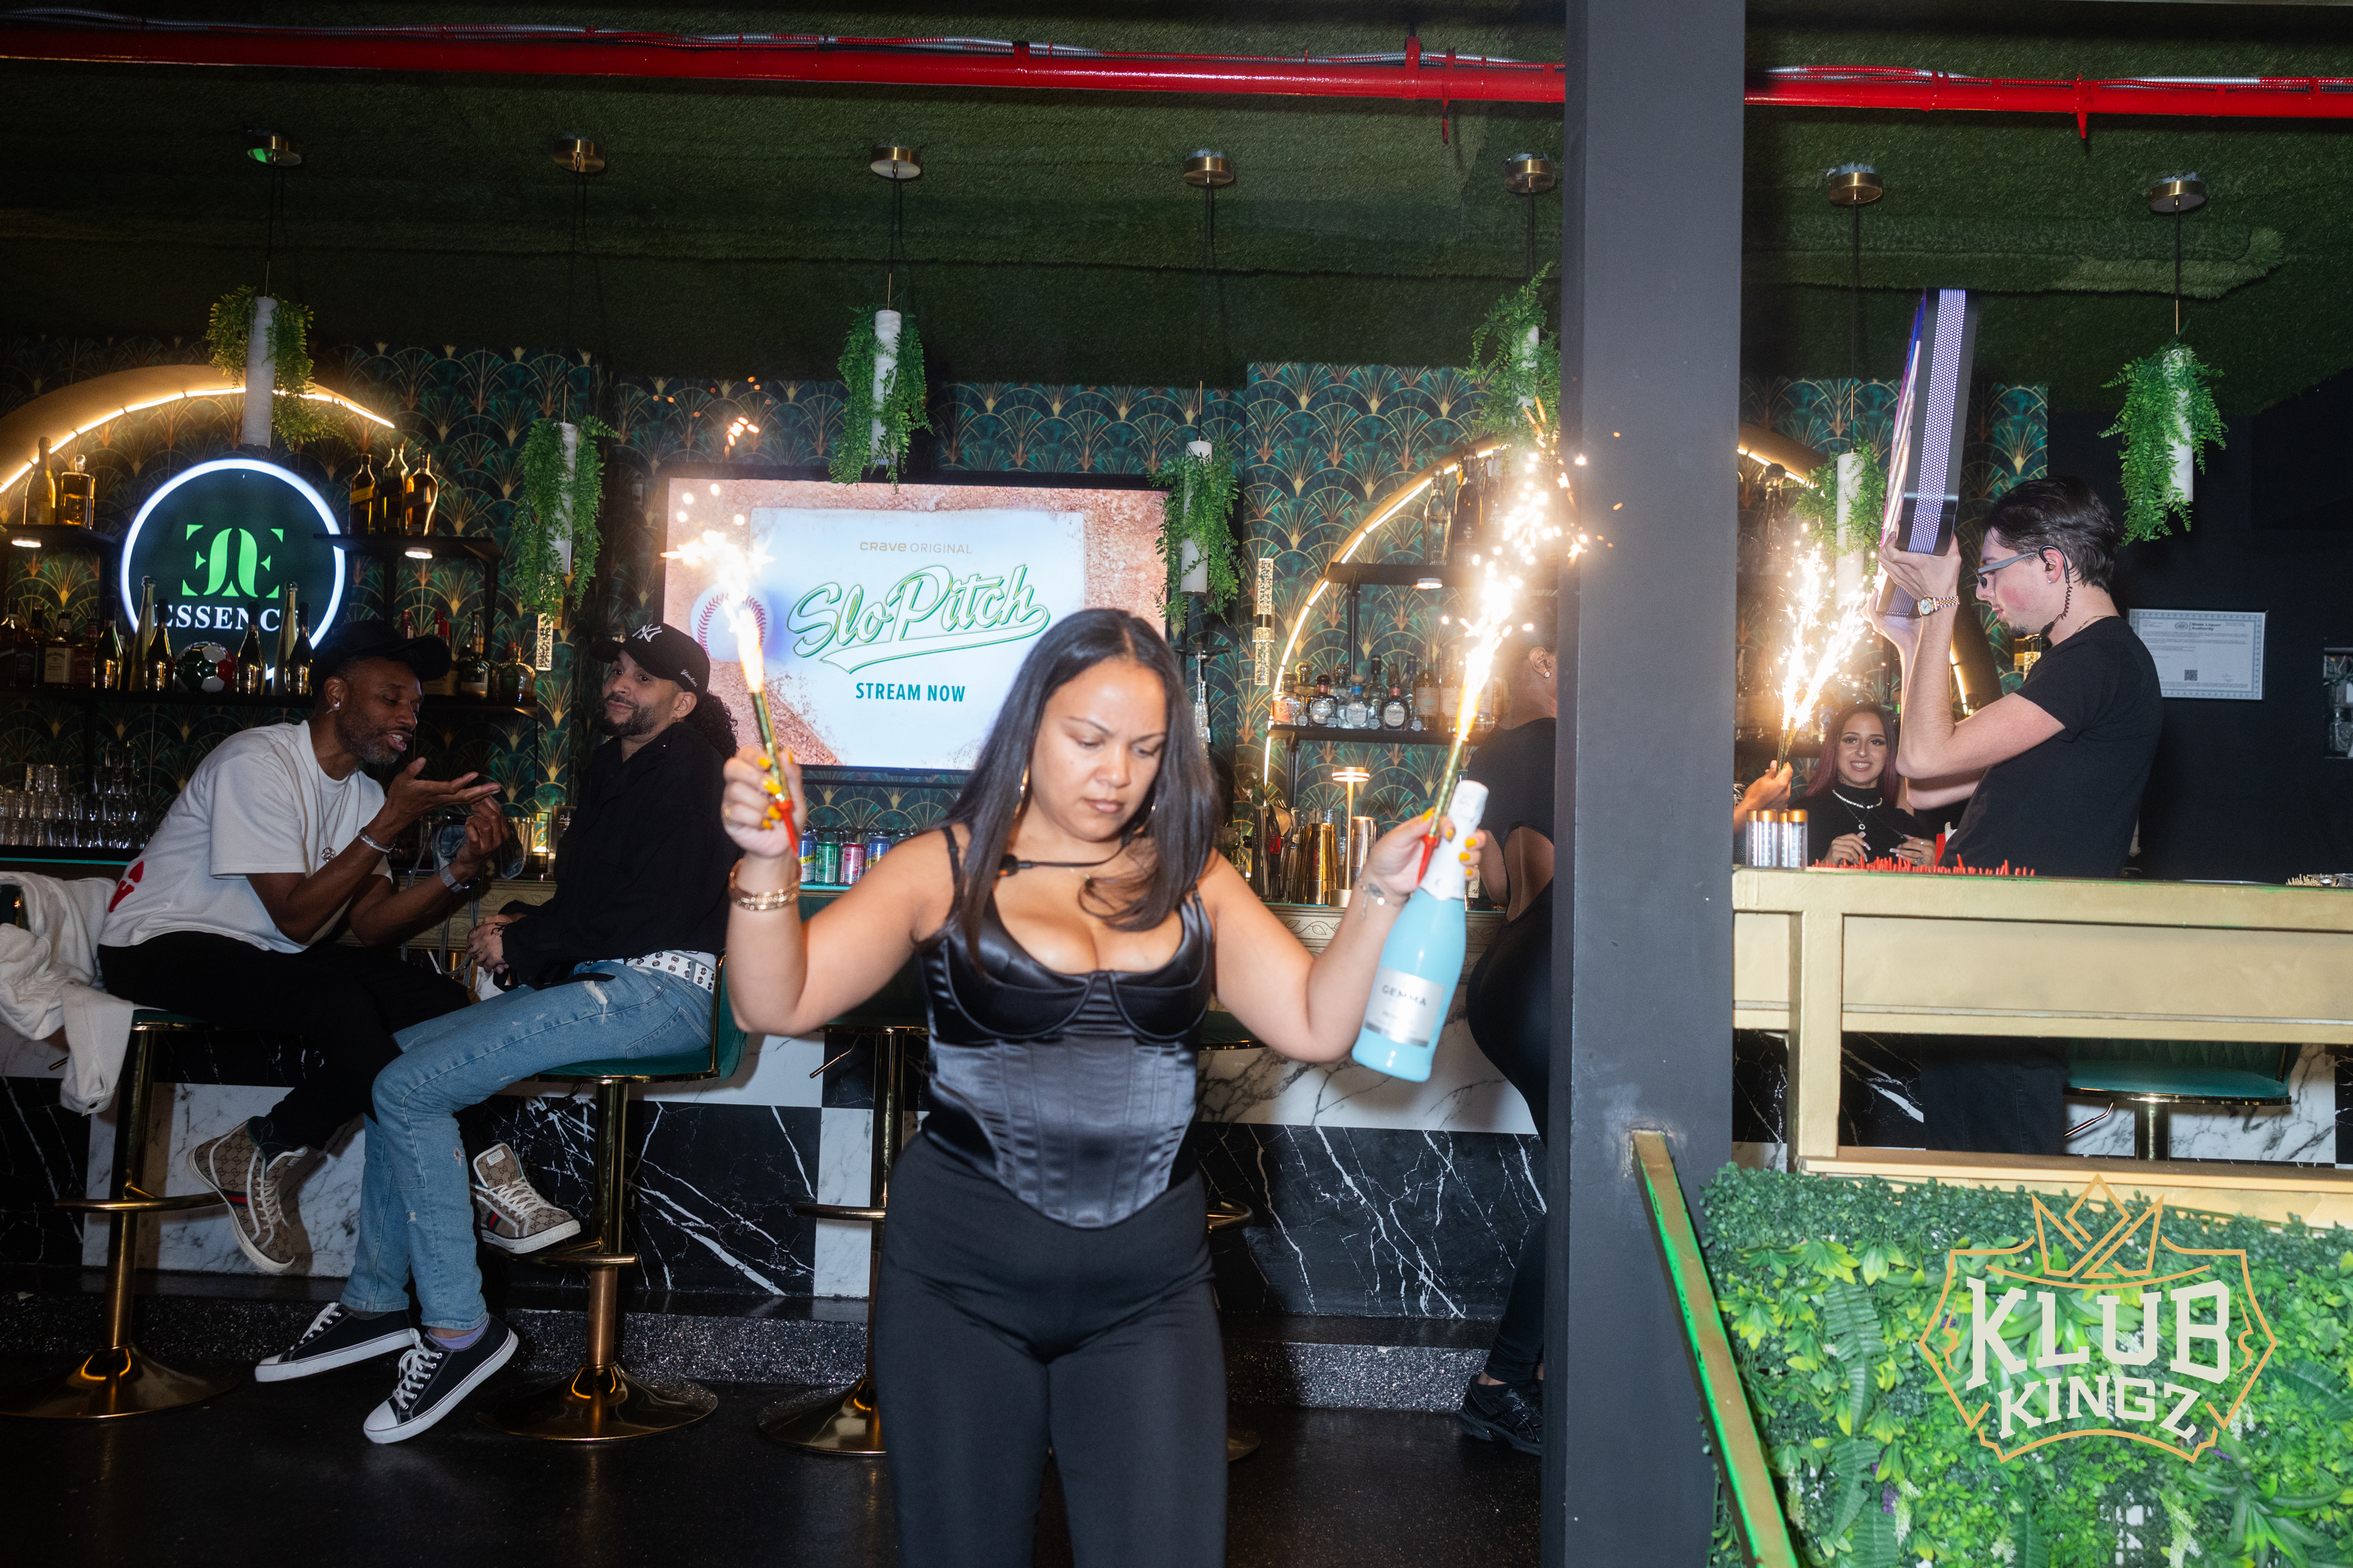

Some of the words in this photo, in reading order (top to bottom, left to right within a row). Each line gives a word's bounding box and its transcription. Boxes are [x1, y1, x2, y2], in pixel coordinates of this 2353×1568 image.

[910, 542, 972, 554] ORIGINAL
[153, 604, 301, 632] ESSENC
[680, 669, 698, 687] Yankees
[855, 682, 921, 700] STREAM
[927, 685, 965, 702] NOW
